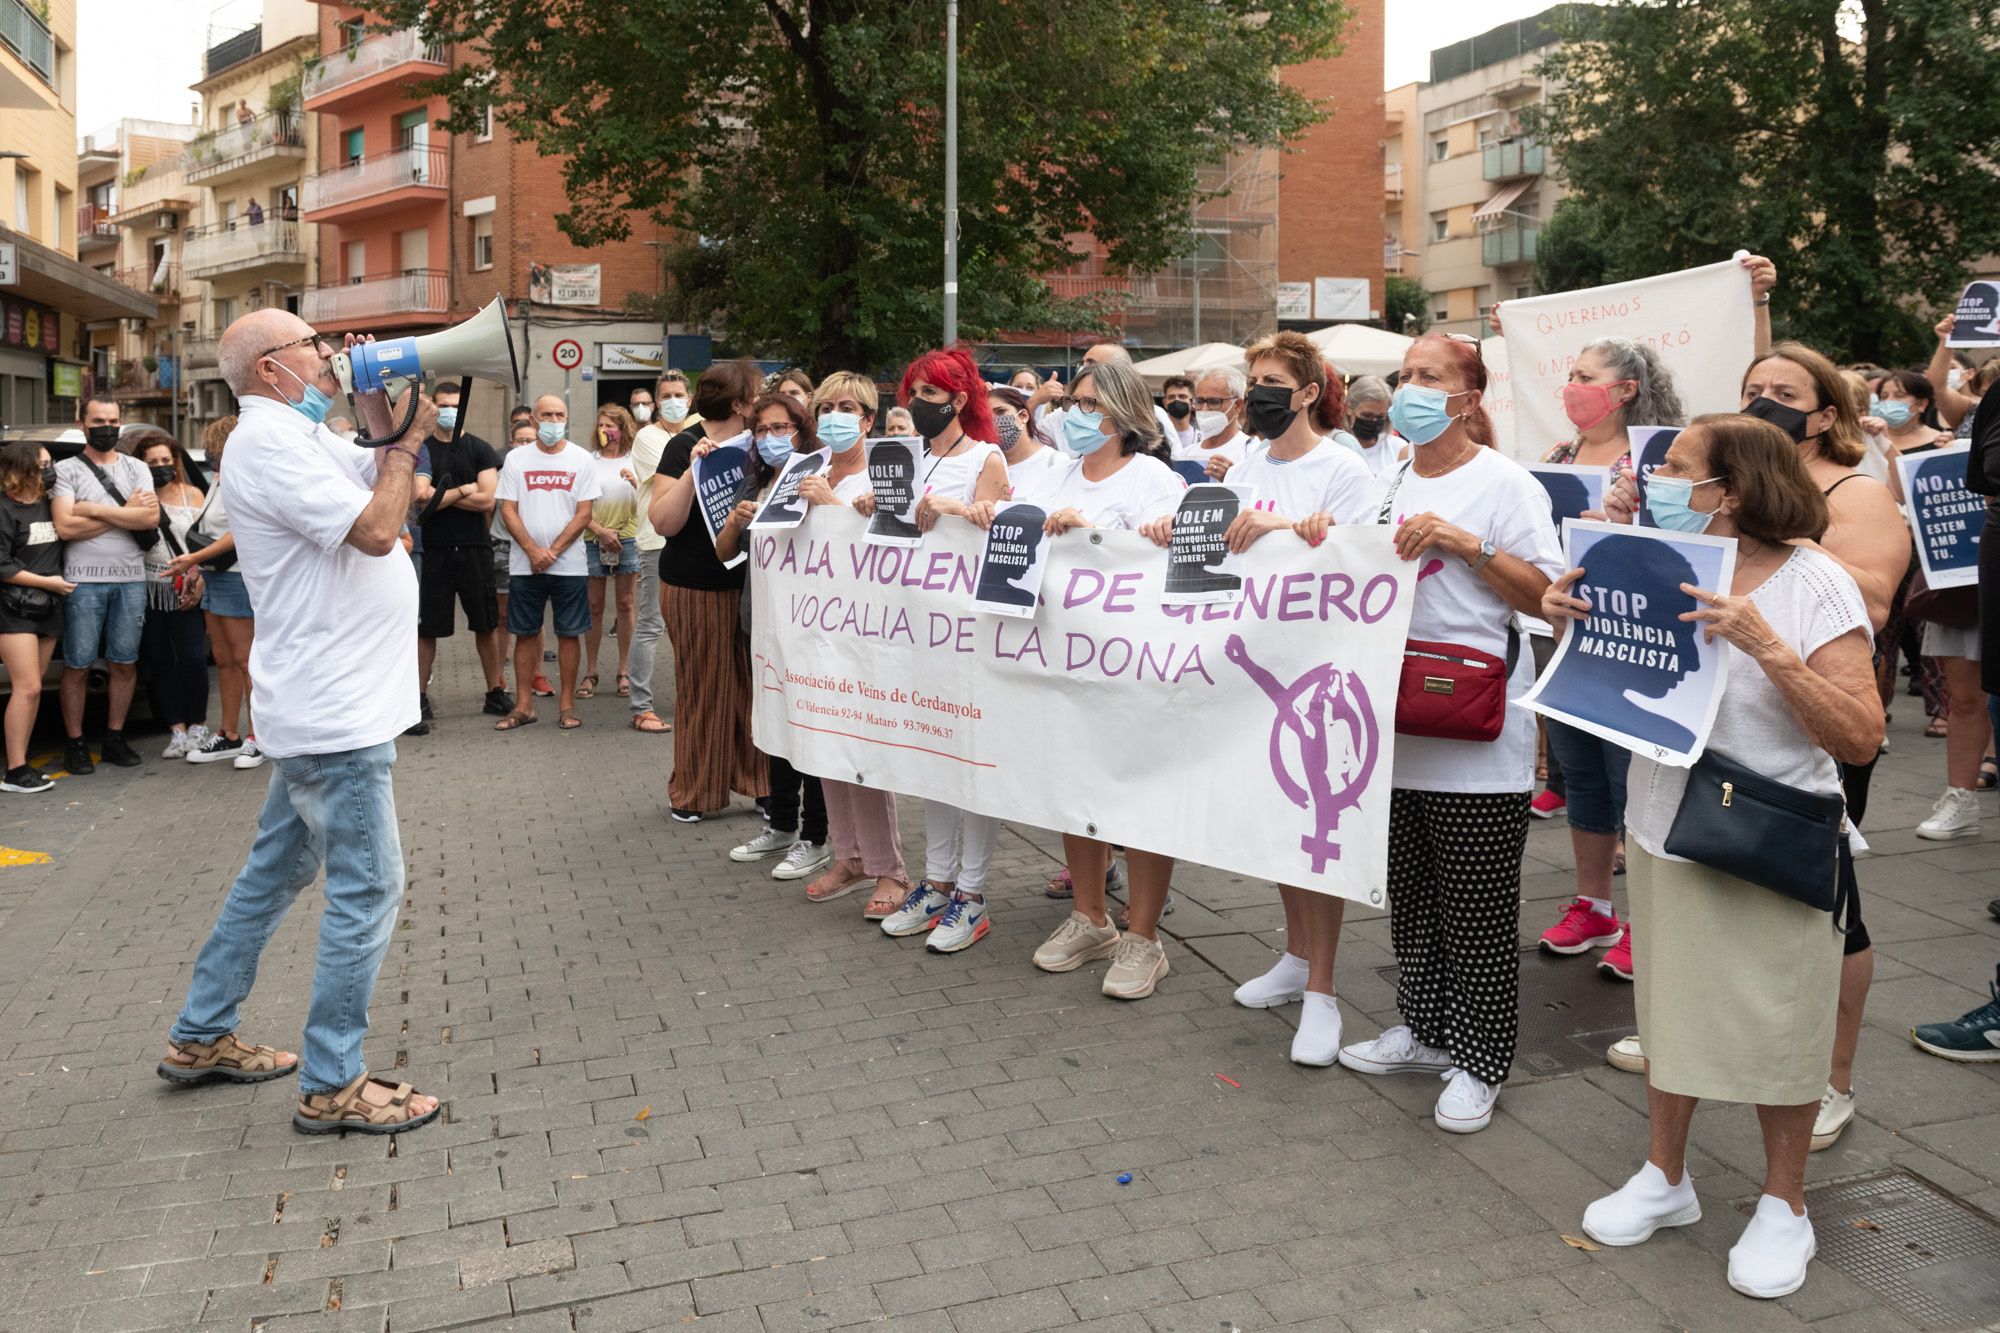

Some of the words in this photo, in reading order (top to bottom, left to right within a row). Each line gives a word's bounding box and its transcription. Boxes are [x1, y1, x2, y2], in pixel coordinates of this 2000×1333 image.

[1537, 296, 1641, 334] QUEREMOS
[560, 348, 576, 358] 20
[870, 464, 904, 478] VOLEM
[700, 466, 744, 496] VOLEM
[1916, 475, 1943, 494] NO
[1946, 480, 1955, 490] A
[706, 487, 734, 506] CAMINAR
[1174, 508, 1224, 526] VOLEM
[1922, 508, 1931, 519] S
[992, 524, 1024, 540] STOP
[1926, 520, 1966, 535] ESTEM
[990, 541, 1028, 554] VIOLÈNCIA
[1173, 545, 1190, 554] PELS
[1192, 543, 1225, 553] NOSTRES
[1930, 534, 1958, 548] AMB
[988, 553, 1028, 566] MASCLISTA
[1174, 554, 1206, 564] CARRERS
[1932, 548, 1954, 560] TU.
[754, 536, 776, 570] NO
[780, 538, 797, 574] A
[804, 539, 834, 578] LA
[1063, 568, 1144, 613] DE
[1161, 572, 1399, 624] NERO
[1579, 584, 1648, 618] STOP
[791, 594, 915, 644] VOCALIA
[929, 612, 976, 652] DE
[995, 621, 1048, 668] LA
[1066, 632, 1214, 686] DONA
[1583, 616, 1676, 648] VIOLÈNCIA
[1578, 636, 1679, 672] MASCLISTA
[784, 668, 836, 691] Associació
[838, 678, 854, 694] de
[890, 688, 908, 704] de
[911, 690, 982, 720] Cerdanyola
[841, 708, 862, 722] 92-94
[865, 712, 898, 729] Mataró
[903, 720, 954, 740] 93.799.96.37
